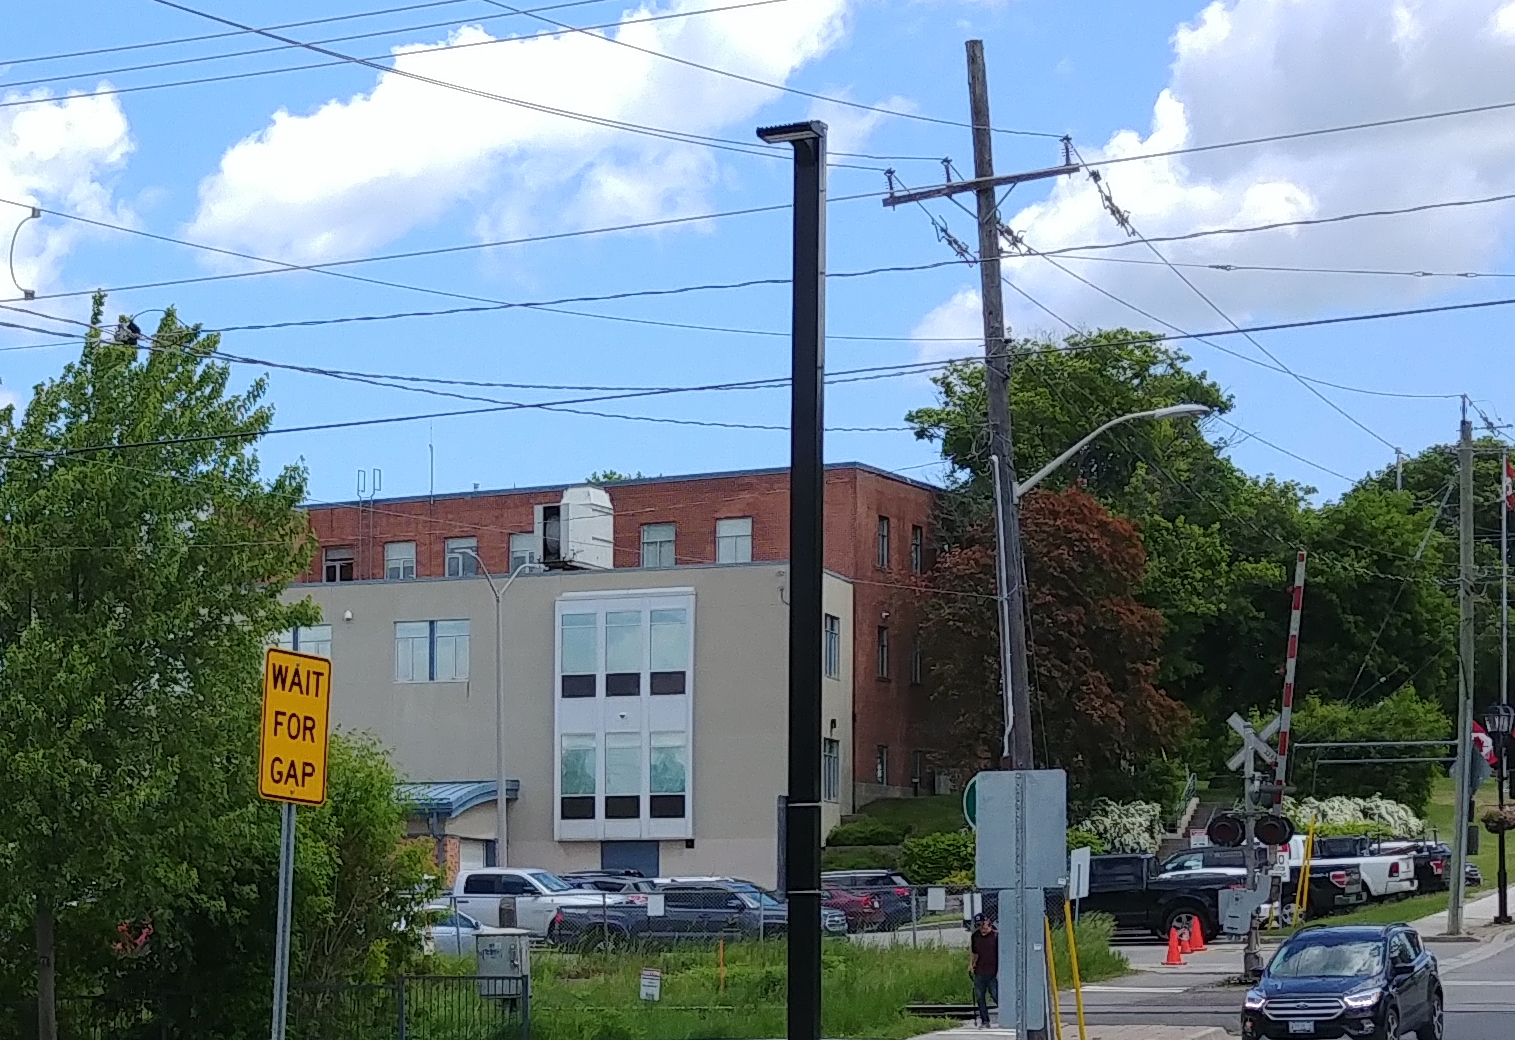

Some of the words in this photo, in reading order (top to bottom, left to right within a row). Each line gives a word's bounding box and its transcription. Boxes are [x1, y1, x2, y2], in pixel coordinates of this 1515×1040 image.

[272, 662, 324, 698] WAIT
[273, 710, 316, 744] FOR
[270, 756, 315, 788] GAP
